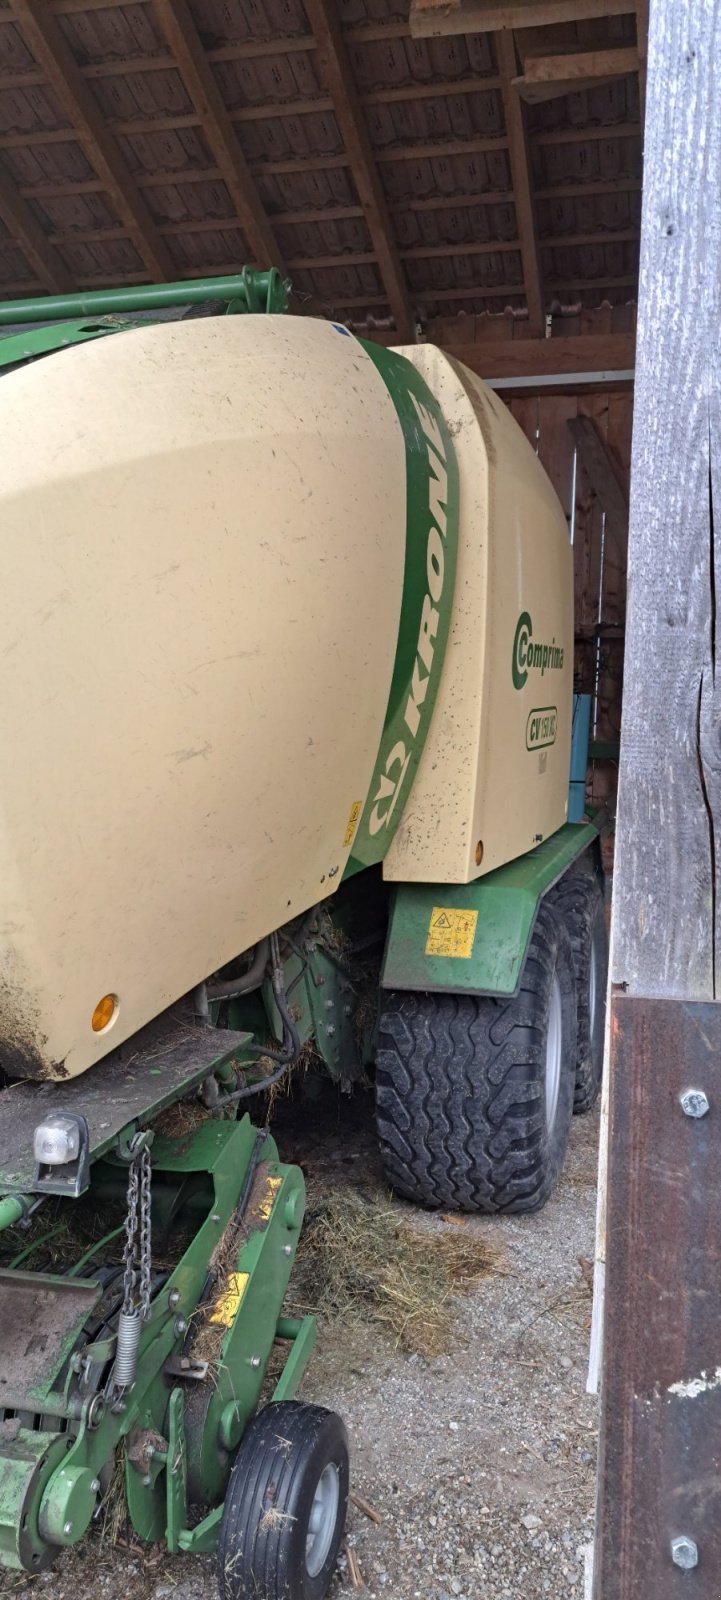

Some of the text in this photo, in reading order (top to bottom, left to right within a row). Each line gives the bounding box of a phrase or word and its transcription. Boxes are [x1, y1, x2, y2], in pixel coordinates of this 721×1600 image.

[404, 389, 448, 737] KRONE
[512, 611, 564, 690] Comprima
[530, 717, 541, 742] CV
